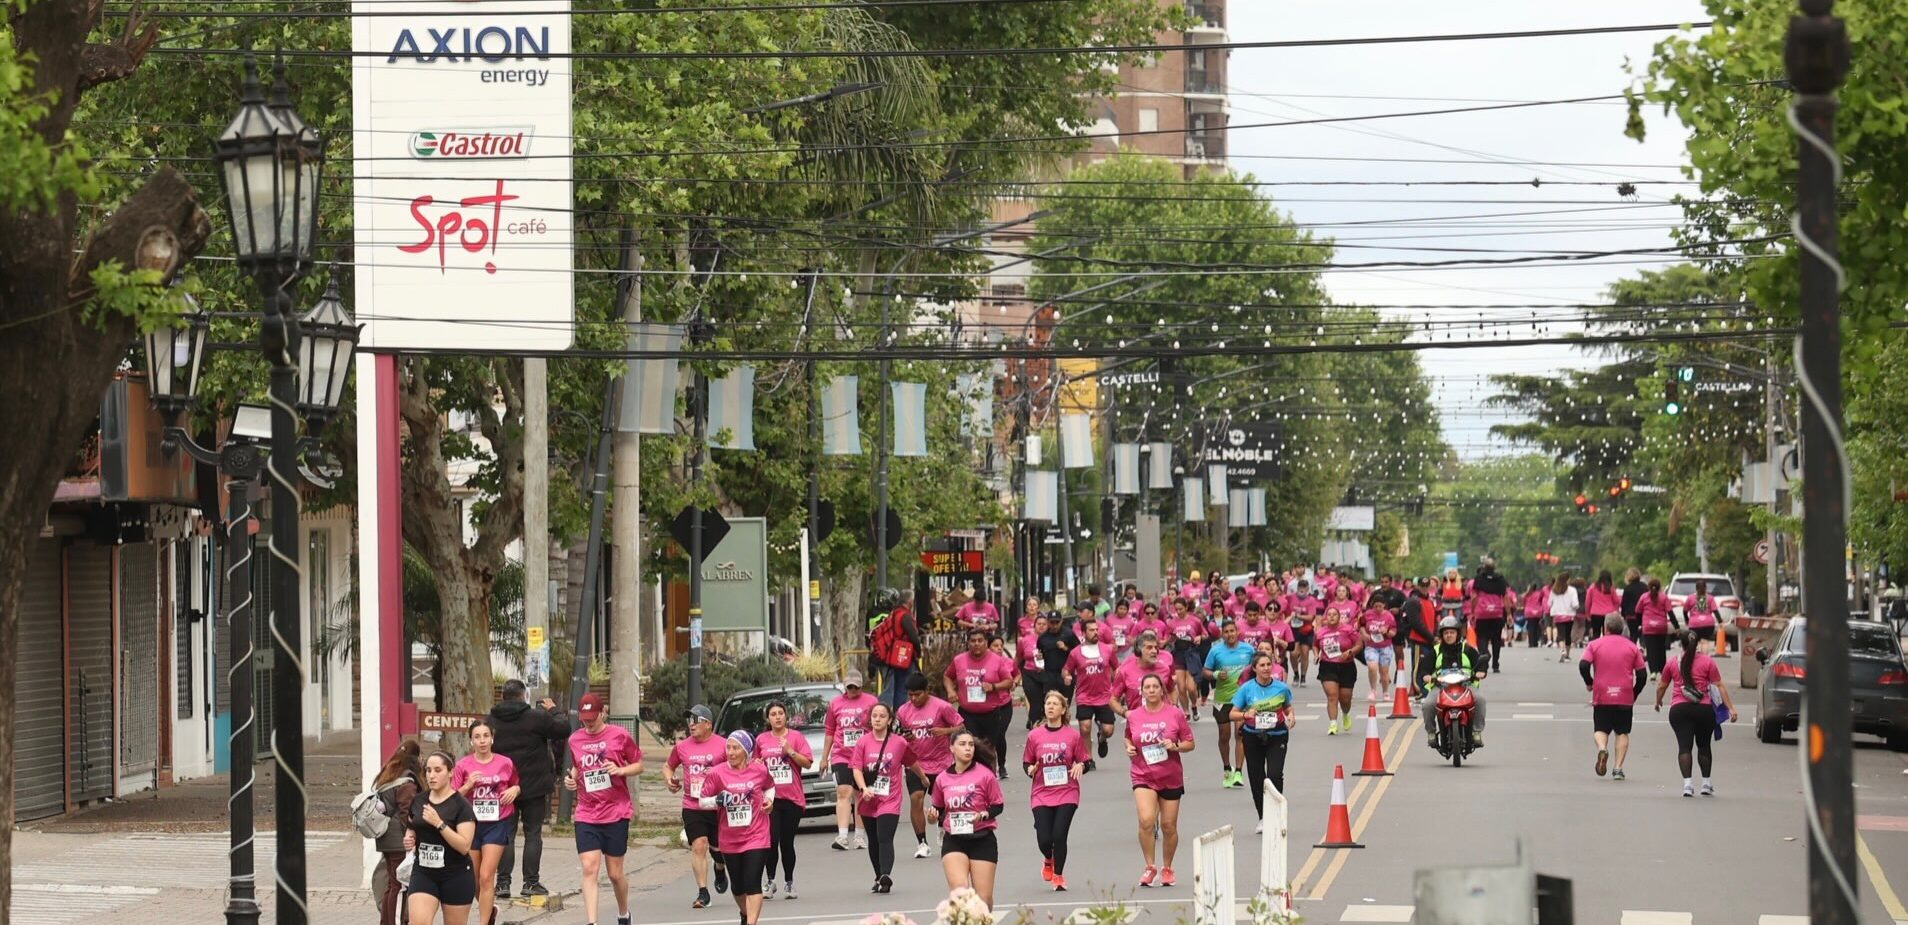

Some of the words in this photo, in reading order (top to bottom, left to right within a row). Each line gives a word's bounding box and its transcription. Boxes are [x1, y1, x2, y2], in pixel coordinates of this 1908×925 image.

[387, 26, 550, 63] AXION
[480, 68, 549, 86] energy
[440, 132, 523, 156] Castrol
[506, 219, 546, 234] café
[1101, 372, 1159, 386] CASTELLI
[589, 775, 606, 784] 3268
[476, 806, 495, 814] 3269
